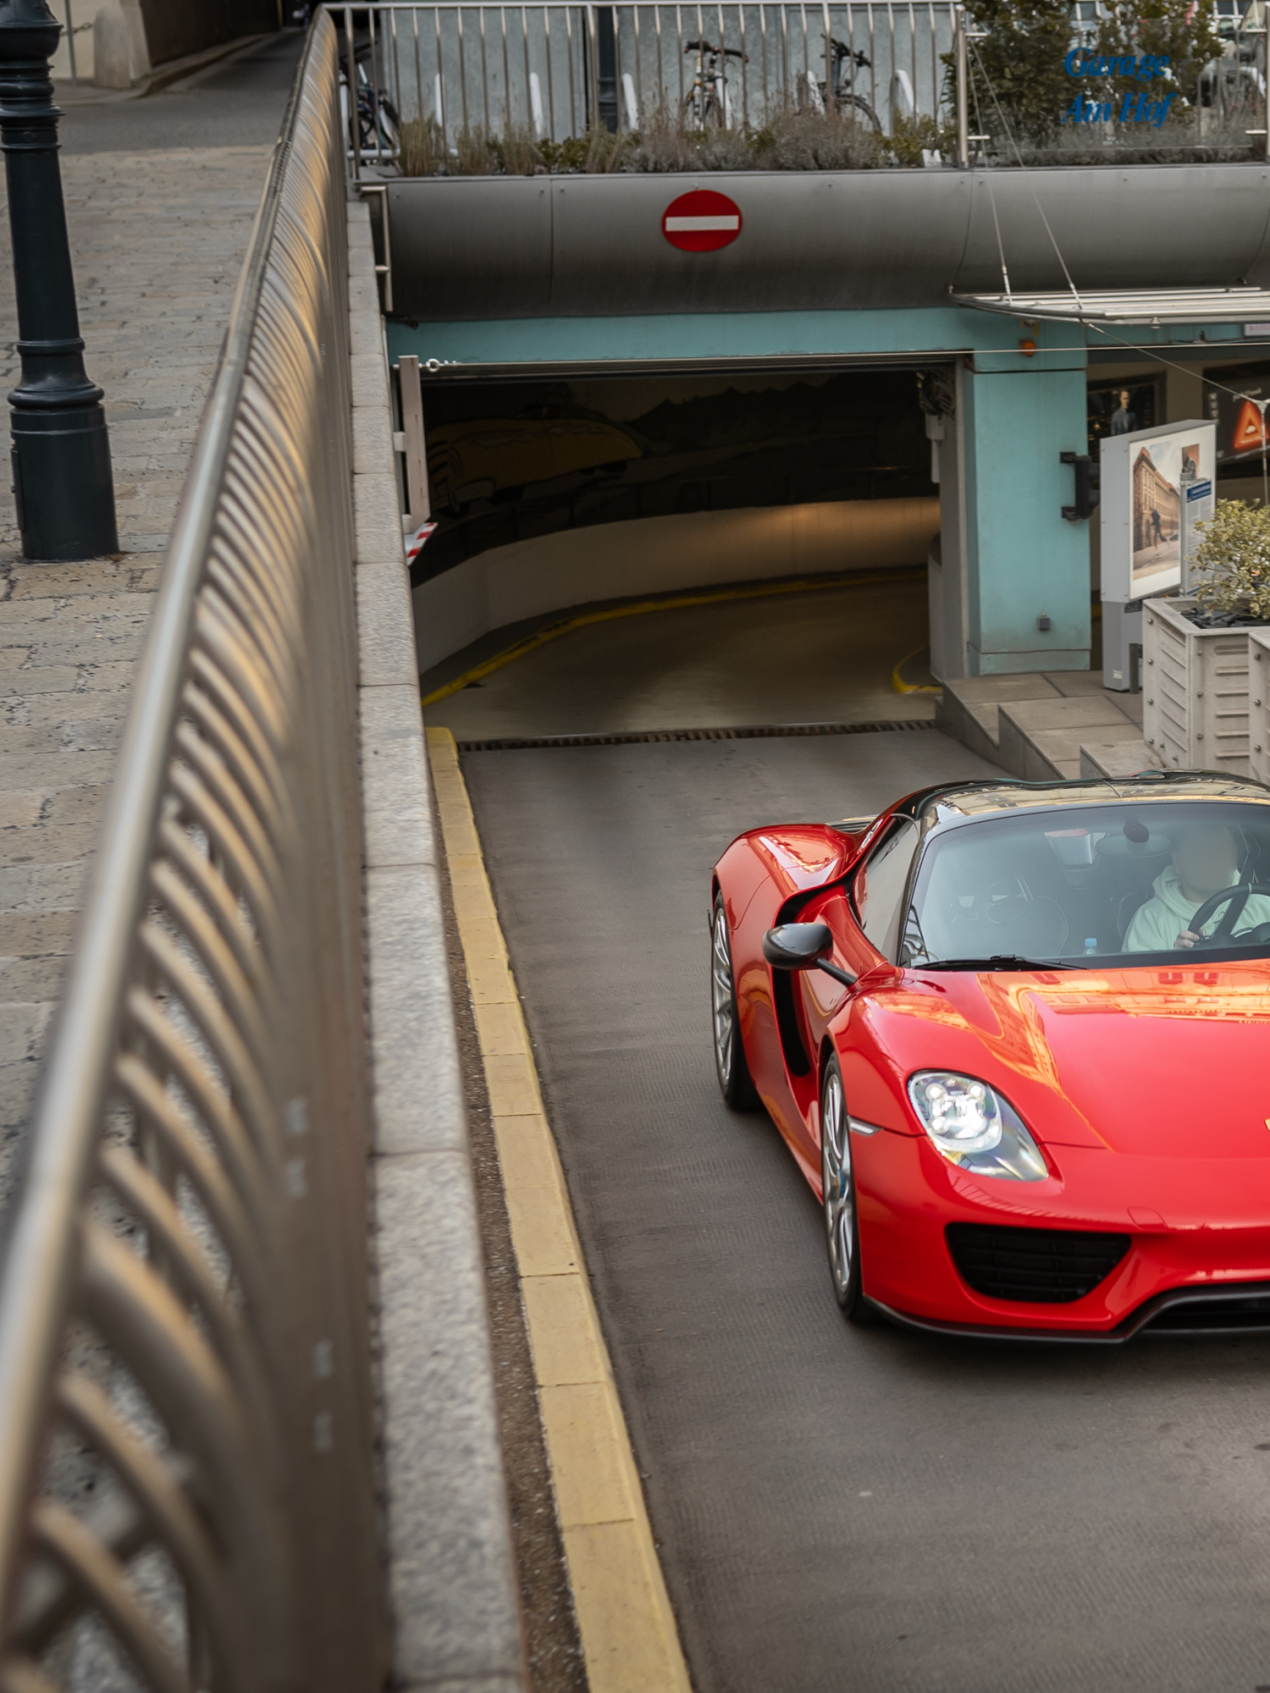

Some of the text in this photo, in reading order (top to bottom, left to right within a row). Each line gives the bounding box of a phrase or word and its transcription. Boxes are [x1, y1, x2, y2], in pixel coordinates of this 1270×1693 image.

[1064, 47, 1170, 82] Garage
[1060, 92, 1178, 128] Am Hof
